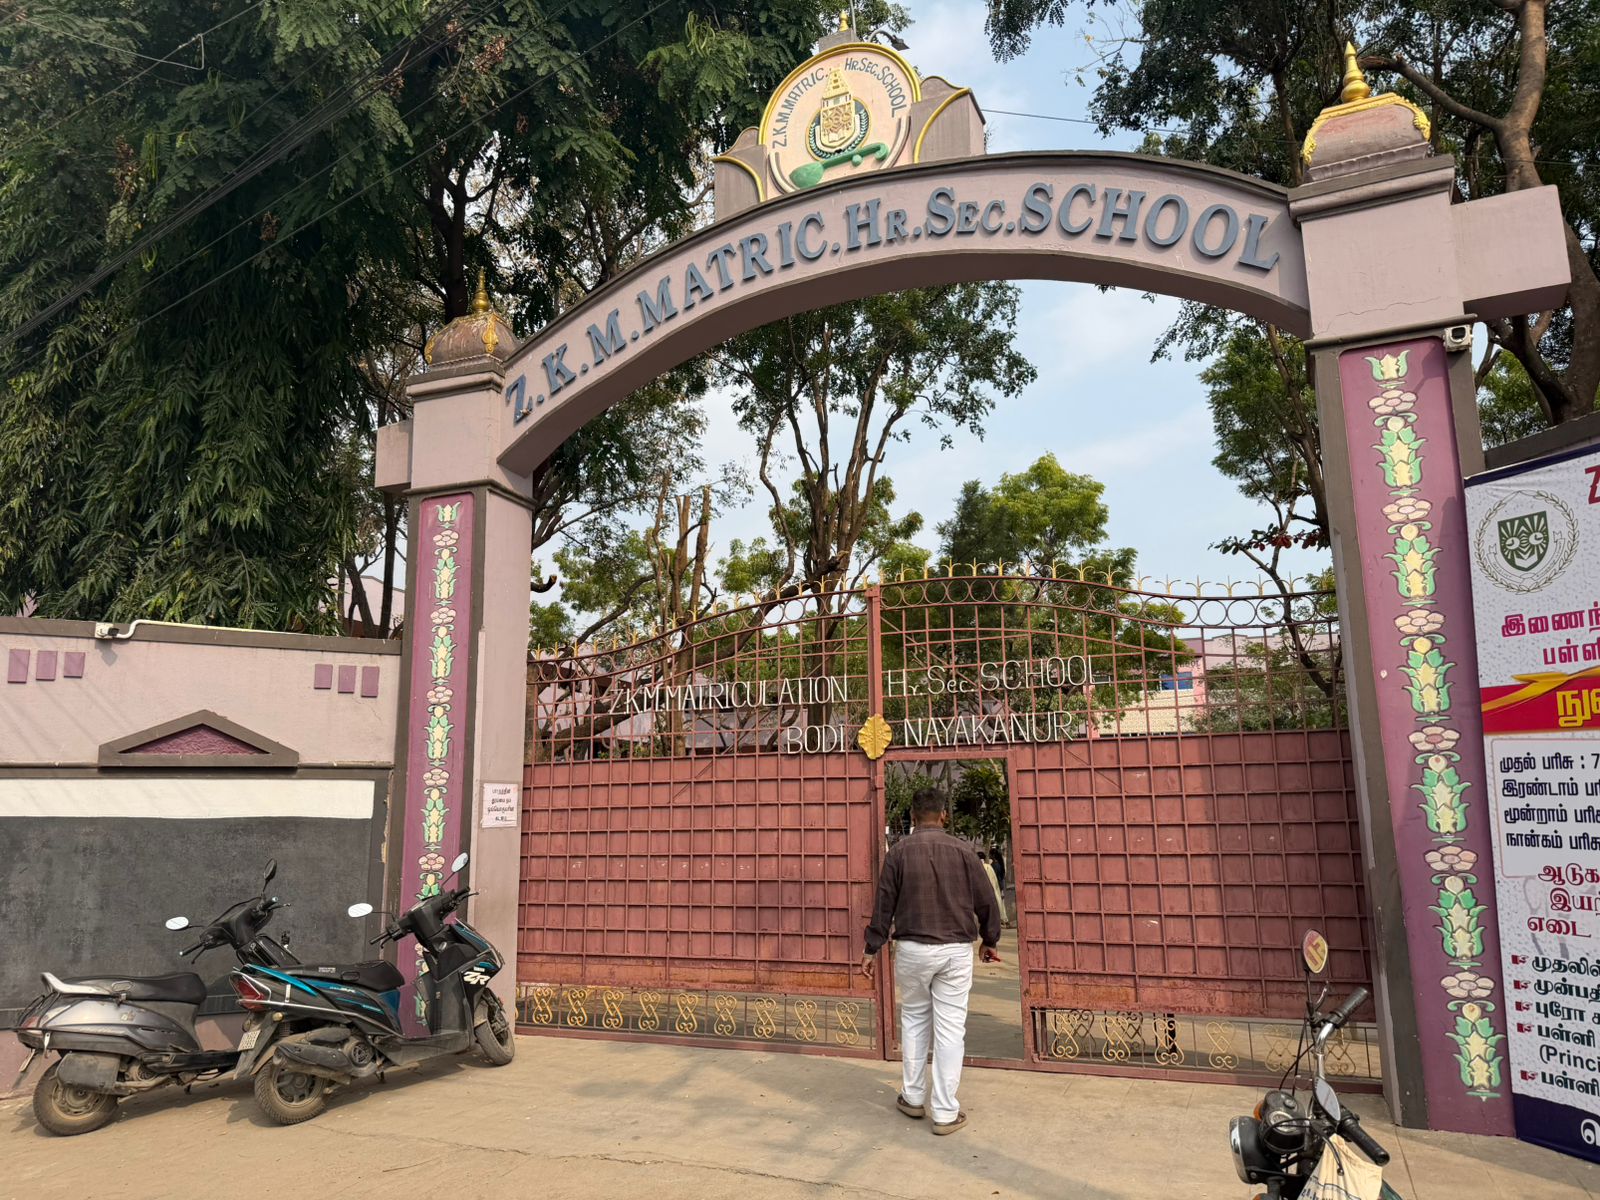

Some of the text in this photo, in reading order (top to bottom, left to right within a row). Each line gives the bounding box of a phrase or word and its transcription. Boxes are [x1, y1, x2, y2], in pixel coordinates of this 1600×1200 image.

[980, 655, 1111, 692] SCHOOL
[787, 711, 1074, 755] BODI NAYAKANUR
[1500, 752, 1537, 773] முதல்
[1542, 752, 1575, 770] பரிசு
[1502, 777, 1579, 799] இரண்டாம்
[1504, 803, 1568, 825] மூன்றாம்
[1527, 916, 1592, 938] எடை
[1537, 1023, 1596, 1048] பள்ளி
